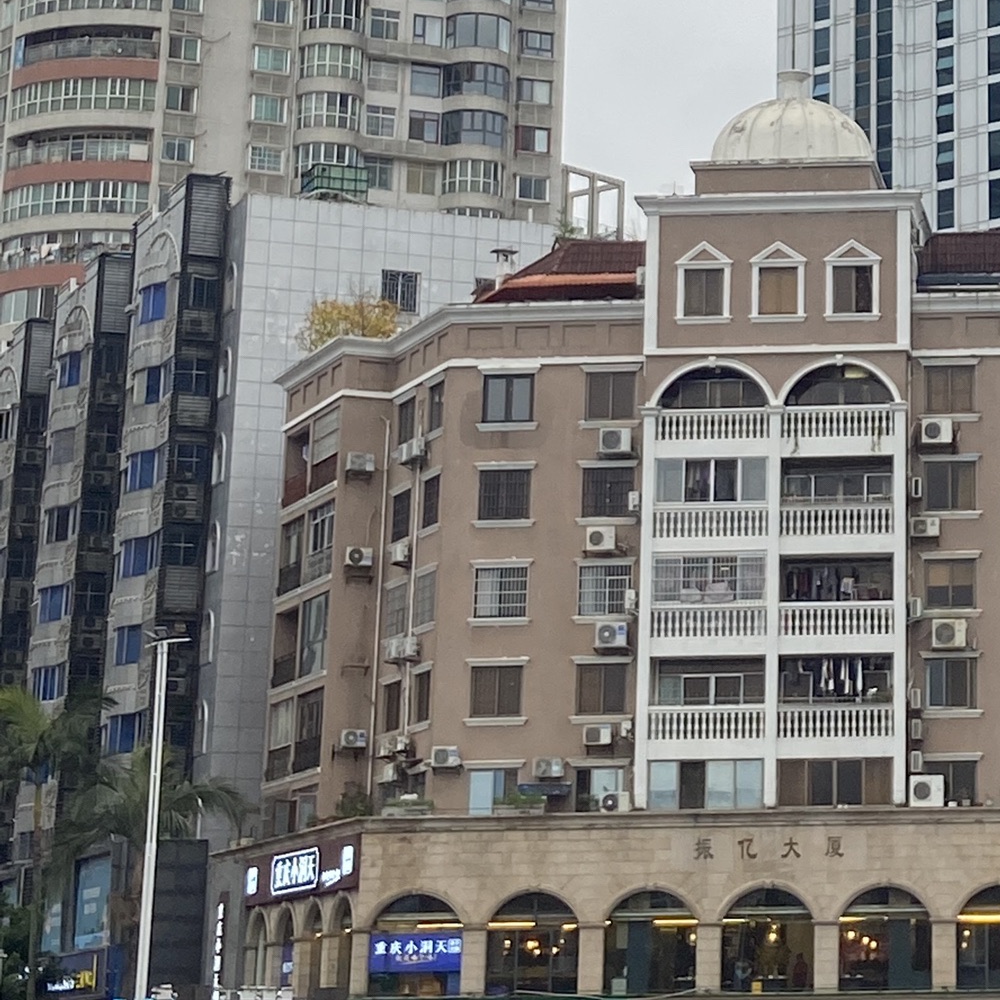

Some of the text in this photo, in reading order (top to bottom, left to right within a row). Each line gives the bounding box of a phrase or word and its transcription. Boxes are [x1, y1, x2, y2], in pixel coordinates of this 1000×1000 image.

[693, 836, 844, 860] 振亿大厦
[374, 940, 447, 955] 重庆小洞天
